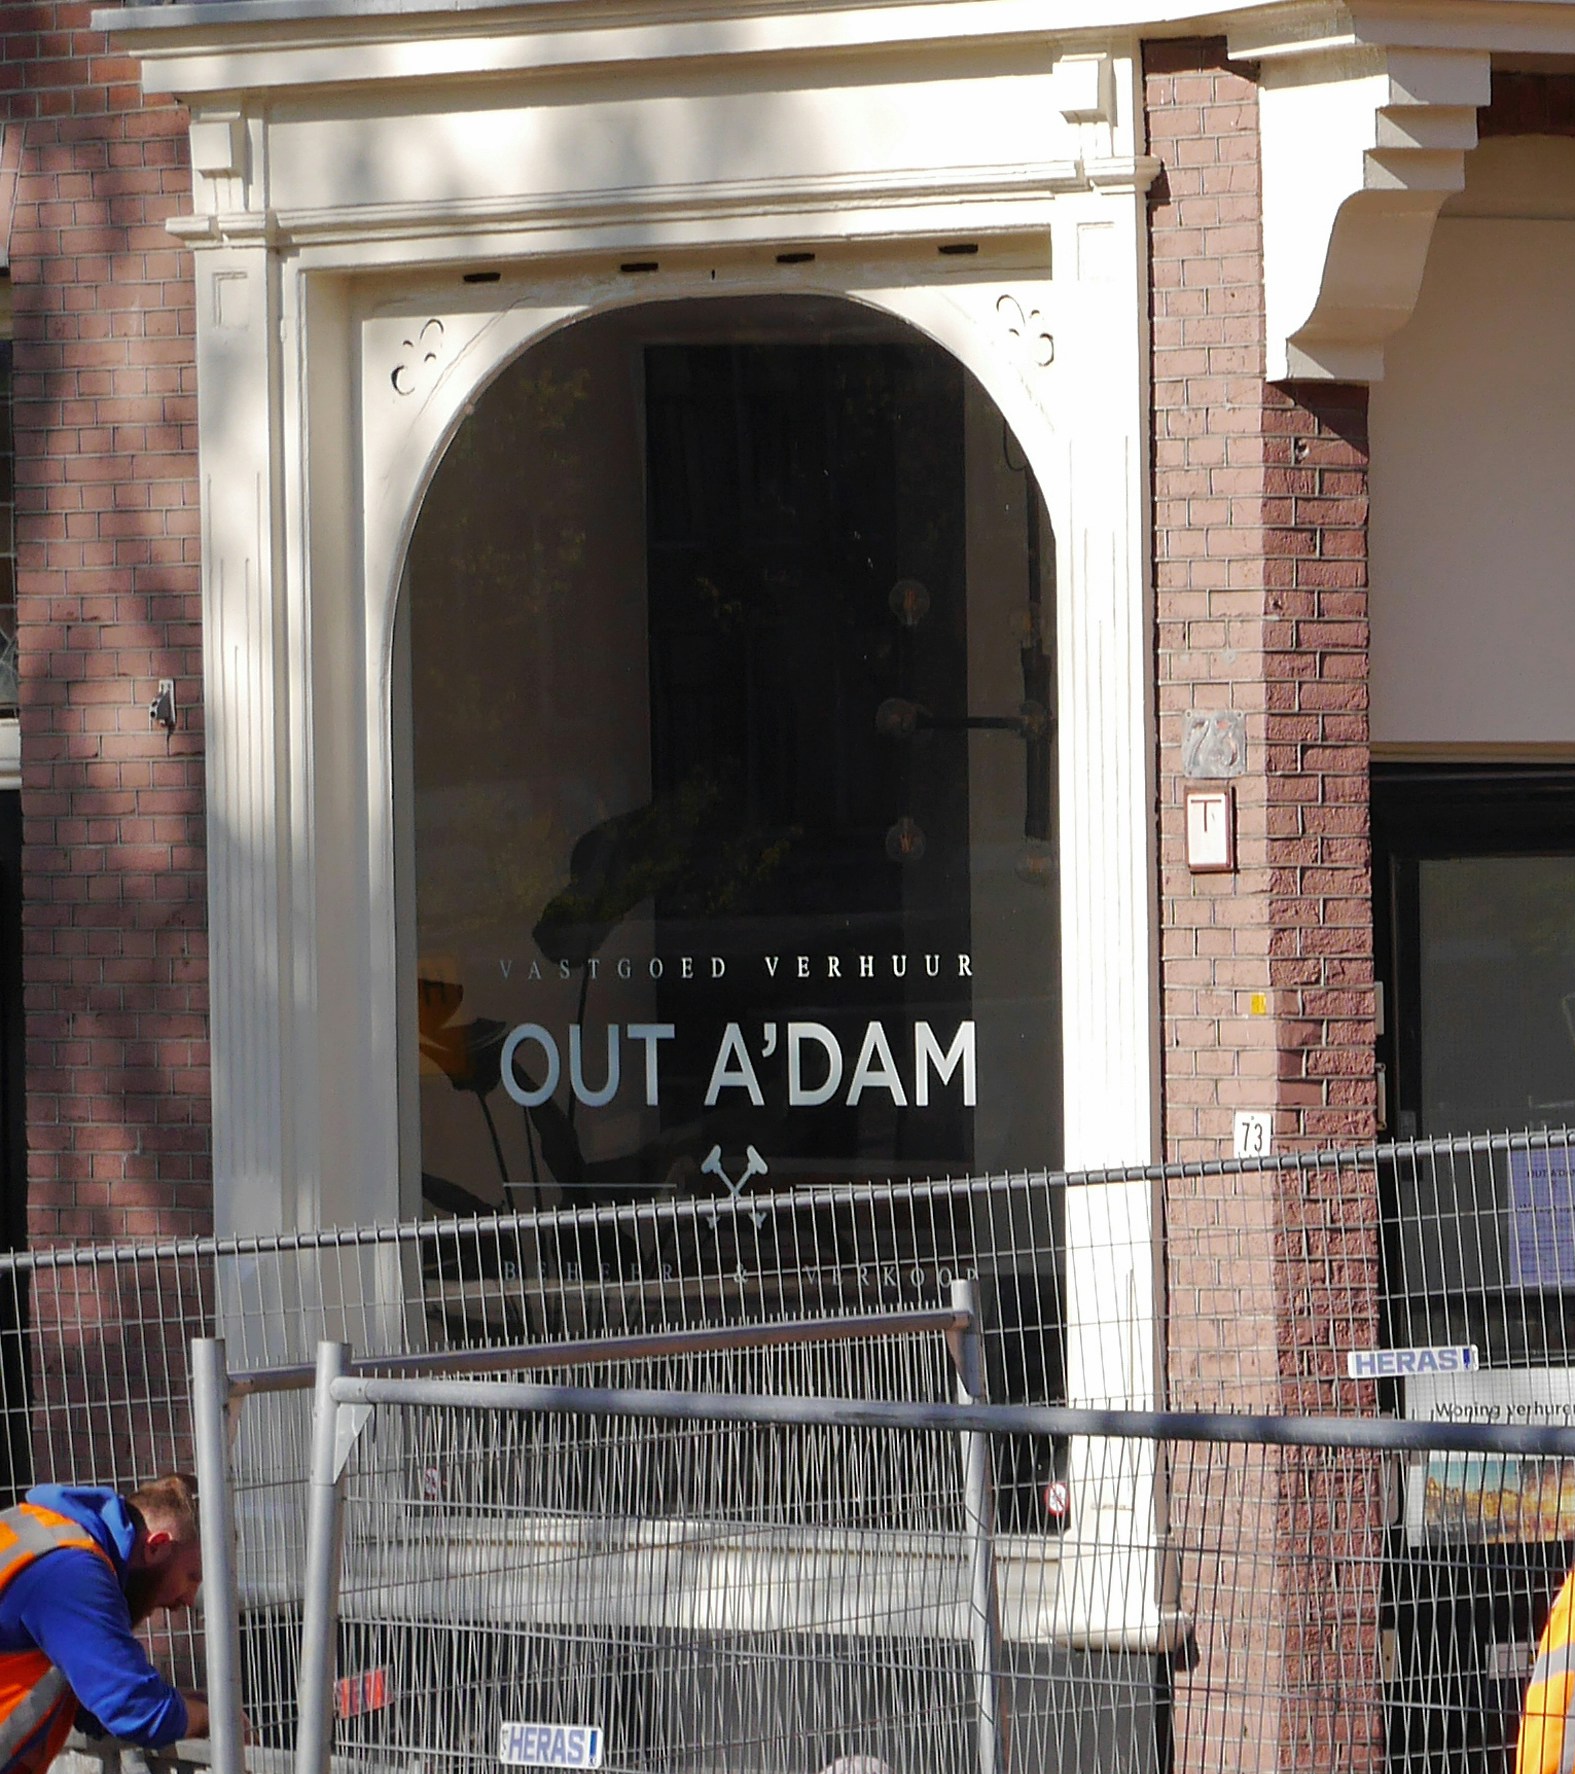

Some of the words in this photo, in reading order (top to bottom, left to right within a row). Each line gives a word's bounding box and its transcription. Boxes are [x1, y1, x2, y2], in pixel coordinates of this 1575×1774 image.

[500, 956, 726, 980] VASTGOED
[764, 954, 973, 977] VERHUUR
[500, 1022, 675, 1107] OUT
[703, 1020, 978, 1107] A'DAM
[1241, 1121, 1264, 1152] 73
[1355, 1348, 1459, 1376] HERAS
[1435, 1401, 1500, 1420] Woning
[508, 1725, 585, 1765] HERAS
